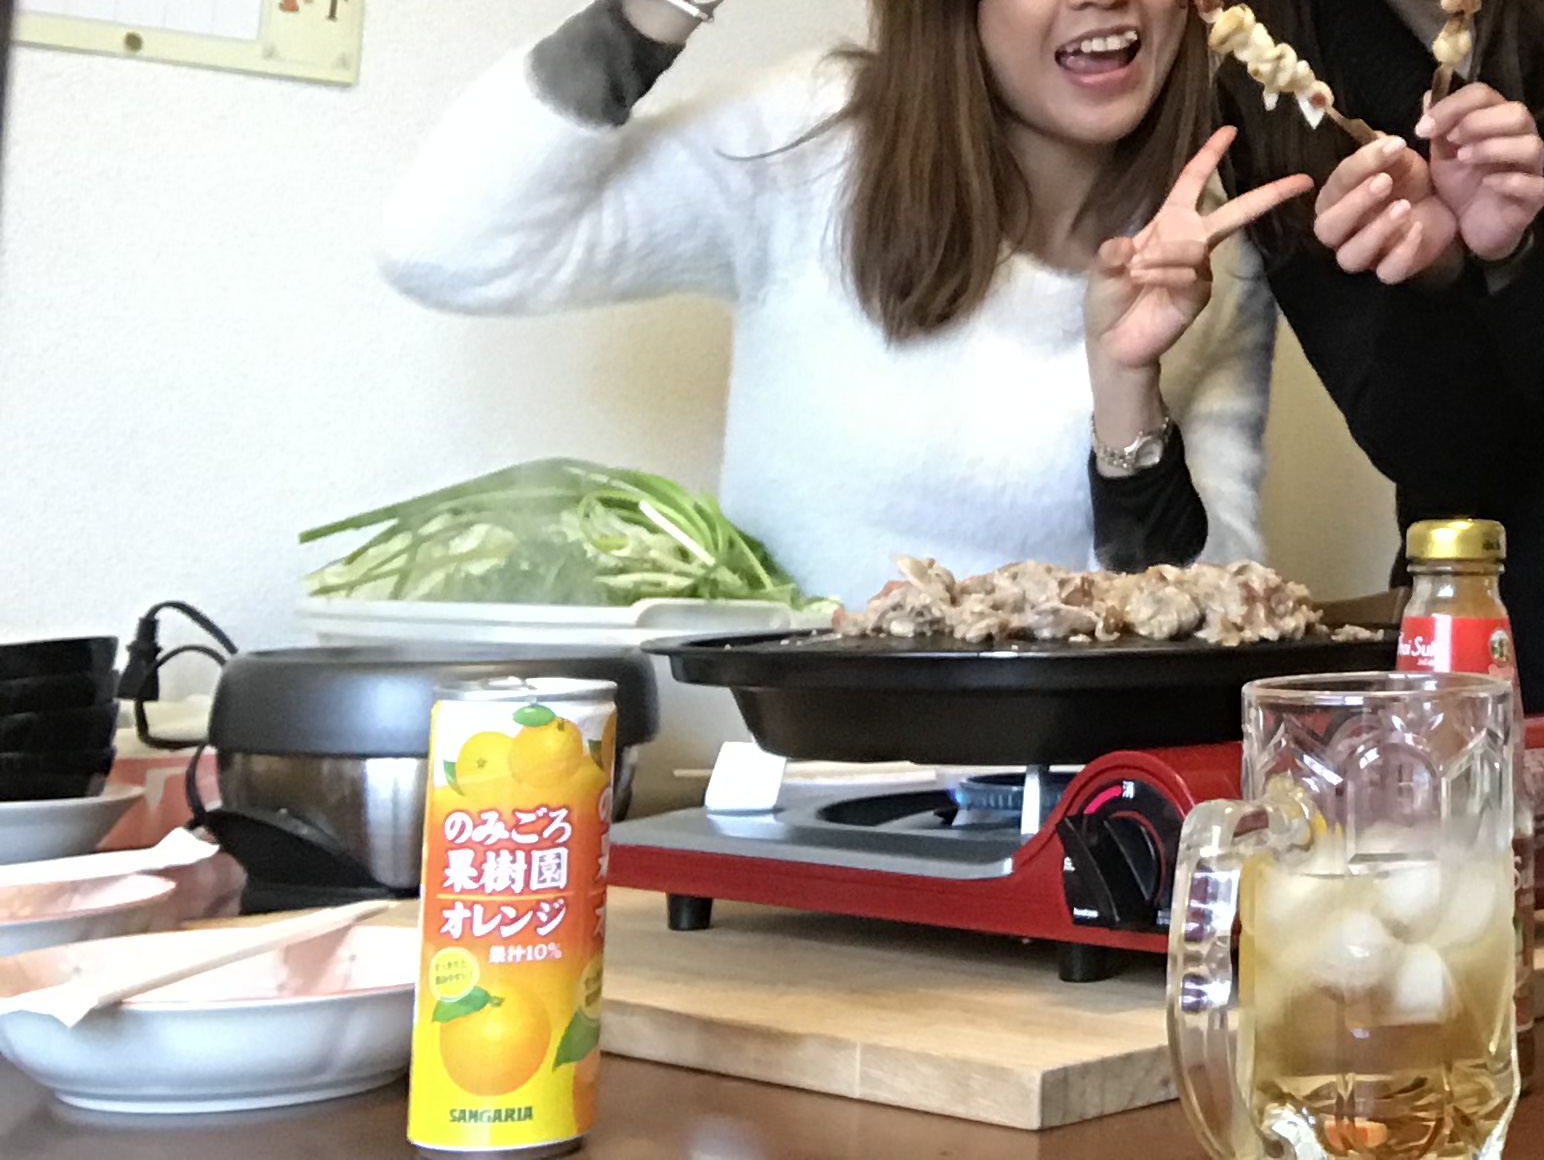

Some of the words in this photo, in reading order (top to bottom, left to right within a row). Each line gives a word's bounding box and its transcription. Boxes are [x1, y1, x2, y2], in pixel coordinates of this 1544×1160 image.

[444, 807, 572, 845] のみごろ
[442, 847, 569, 893] 果樹園
[440, 898, 566, 939] オレンジ
[488, 942, 562, 963] 果汁10%
[449, 1105, 534, 1124] SANGARIA
